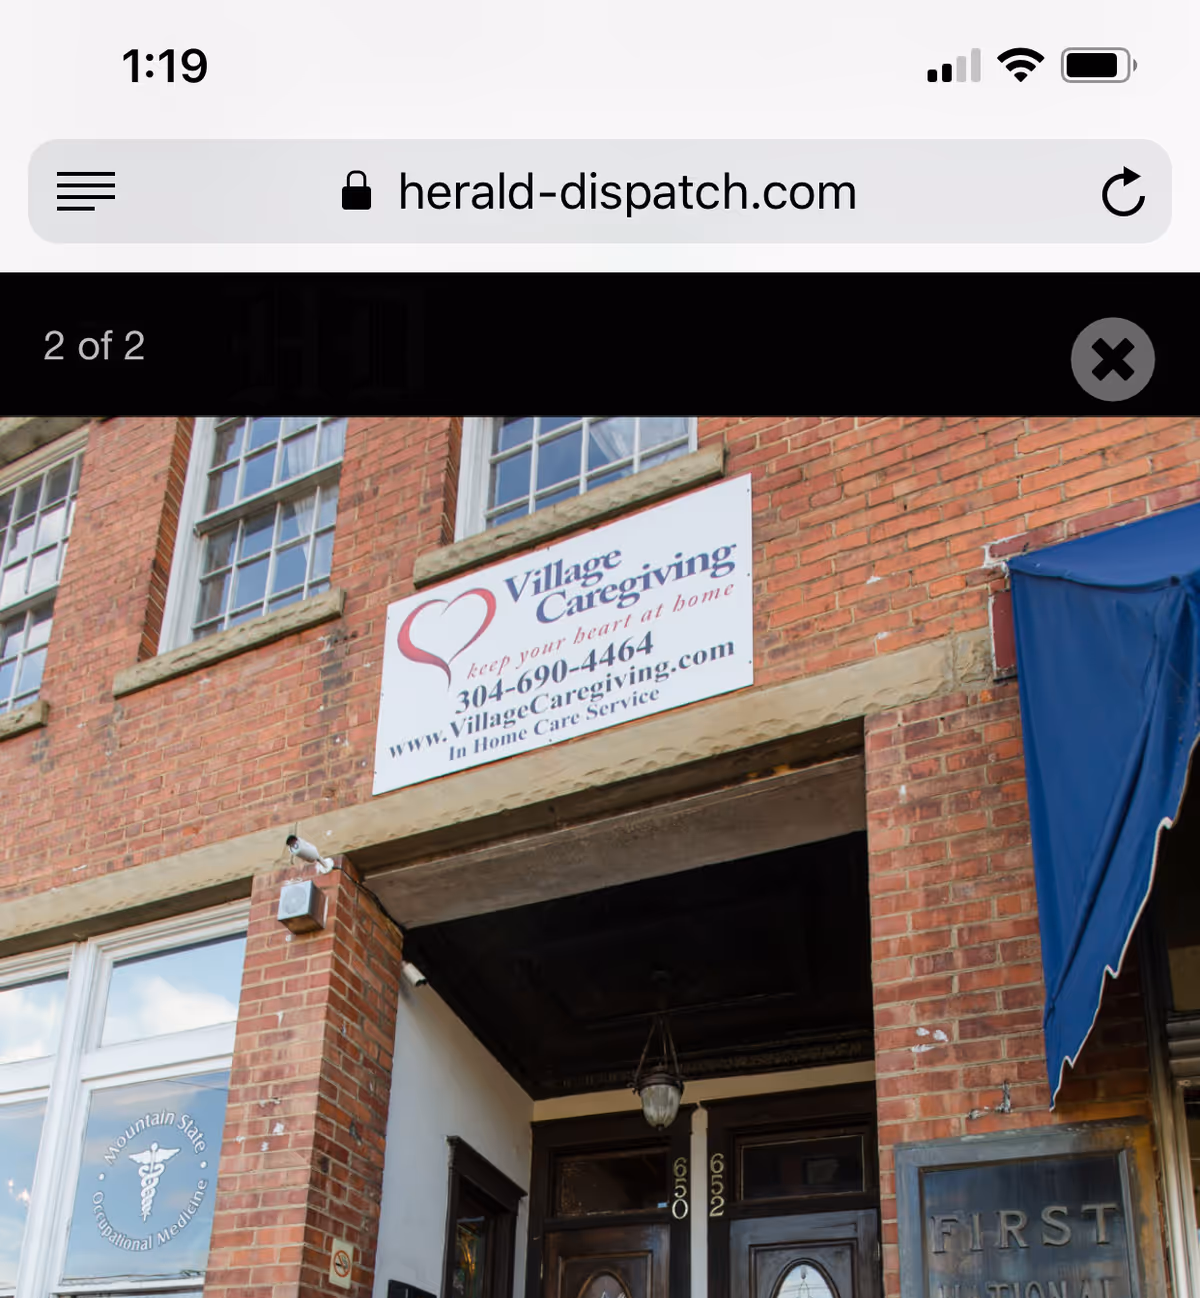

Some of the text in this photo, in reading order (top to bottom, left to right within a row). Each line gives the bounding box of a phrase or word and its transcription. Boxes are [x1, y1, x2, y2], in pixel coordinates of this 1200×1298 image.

[504, 549, 622, 603] Village
[536, 543, 737, 624] Caregiving
[467, 582, 734, 680] keep your heart at home
[389, 640, 735, 759] www.VillageCaregiving.com
[455, 630, 654, 715] 304-690-4464
[449, 688, 660, 761] In Home Care Service
[104, 1108, 206, 1166] Mountain State
[93, 1179, 208, 1252] Occupational Medicine
[672, 1156, 688, 1220] 650
[709, 1153, 725, 1218] 652
[929, 1202, 1119, 1254] FIRST
